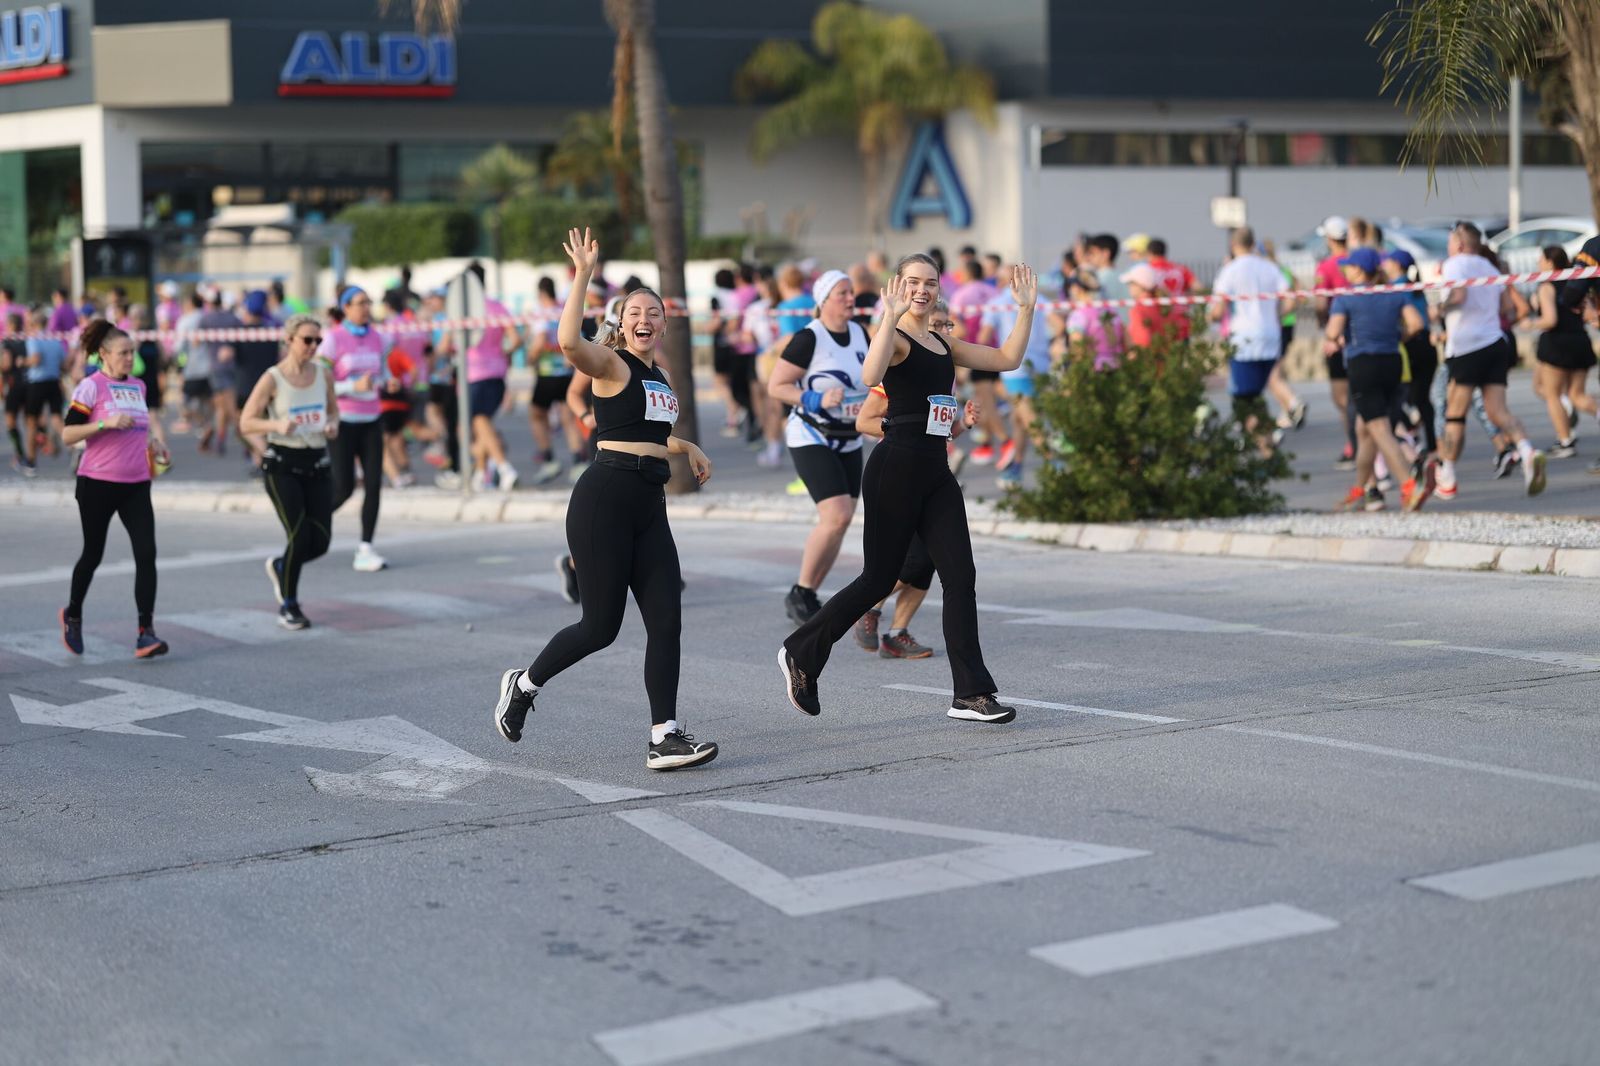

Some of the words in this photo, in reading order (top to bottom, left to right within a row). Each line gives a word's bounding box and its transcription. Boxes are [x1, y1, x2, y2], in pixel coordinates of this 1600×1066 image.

[0, 3, 67, 70] LDI
[280, 31, 456, 84] ALDI
[649, 391, 678, 414] 1135
